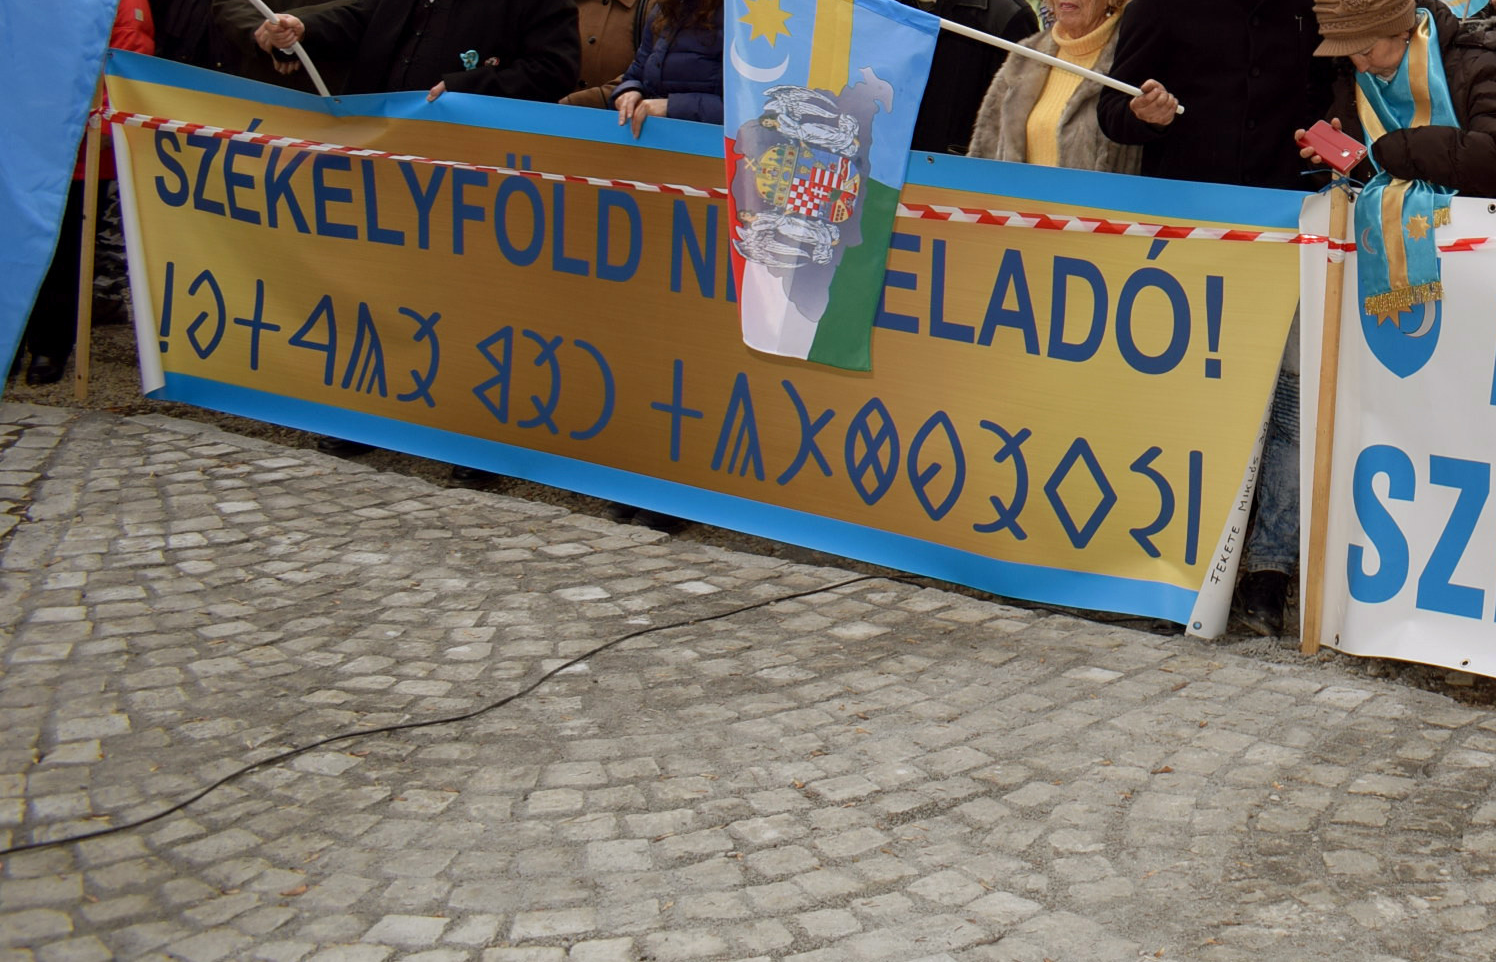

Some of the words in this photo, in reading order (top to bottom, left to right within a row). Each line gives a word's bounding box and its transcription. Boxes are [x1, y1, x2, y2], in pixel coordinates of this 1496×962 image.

[154, 118, 643, 283] SZÉKELYFÖLD
[873, 231, 1225, 379] ELADÓ!
[1210, 525, 1241, 585] FEKETE
[1238, 456, 1259, 512] MIKLÓS
